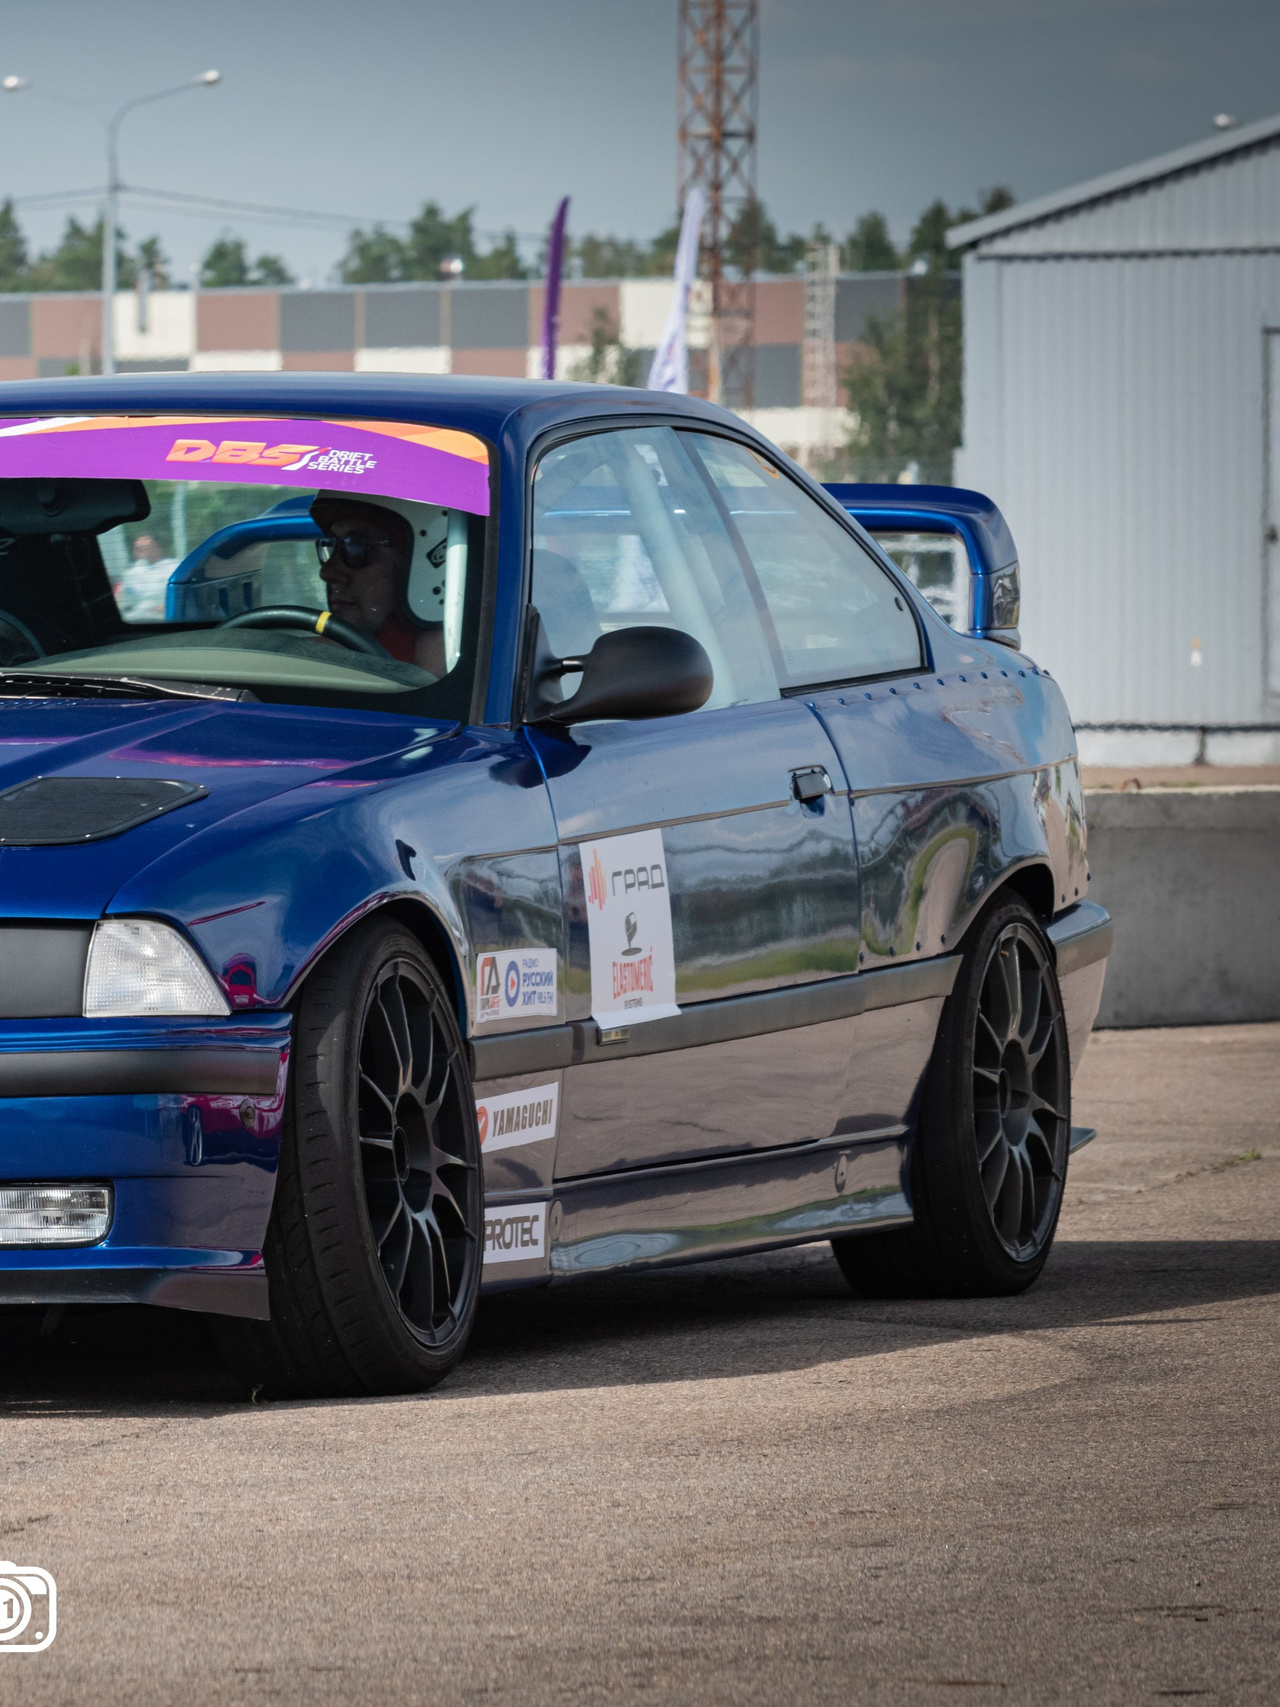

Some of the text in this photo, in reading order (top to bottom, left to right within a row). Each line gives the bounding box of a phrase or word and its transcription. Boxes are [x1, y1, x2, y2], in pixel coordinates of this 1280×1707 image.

[165, 439, 321, 468] DBS
[317, 455, 378, 469] BATTLE
[328, 450, 374, 461] DRIFT
[306, 461, 365, 474] SERIES
[611, 863, 665, 897] ГРАД
[522, 970, 554, 988] РУССКИЙ
[521, 990, 537, 1007] ХИТ
[492, 1098, 553, 1138] YAMAGUCHI
[483, 1214, 539, 1252] PROTEC
